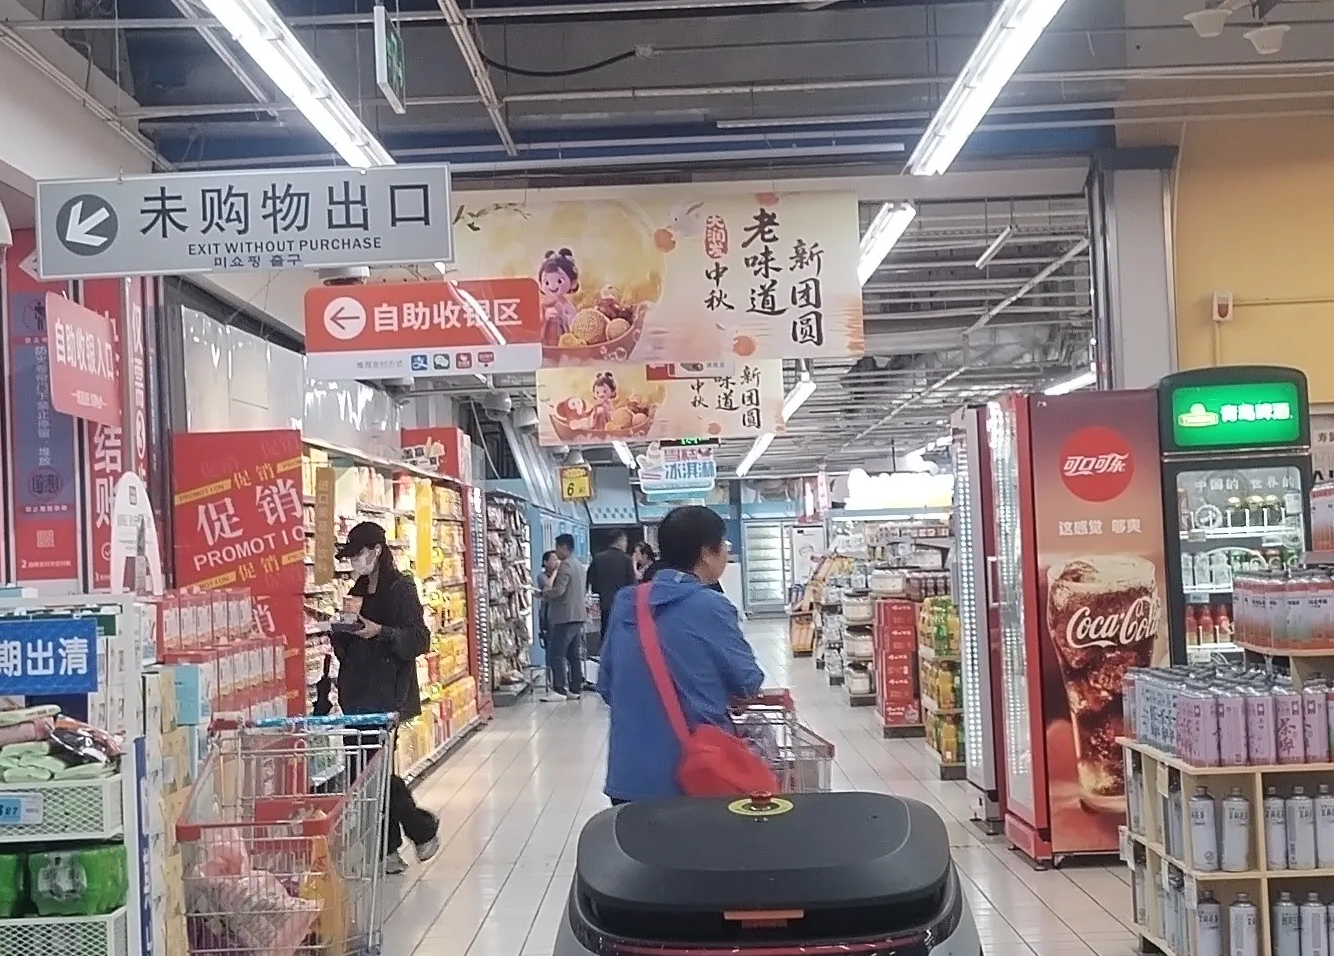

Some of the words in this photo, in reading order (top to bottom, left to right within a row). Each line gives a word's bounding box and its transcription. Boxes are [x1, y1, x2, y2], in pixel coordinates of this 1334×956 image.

[140, 180, 432, 239] 未购物出口
[188, 243, 221, 256] EXIT
[225, 239, 294, 254] WITHOUT
[298, 236, 382, 252] PURCHASE
[269, 254, 303, 267] 출구
[741, 208, 789, 316] 老味道
[704, 262, 735, 312] 中秋
[789, 239, 824, 347] 新团圆
[373, 298, 523, 333] 自助收银区
[55, 318, 115, 383] 自助收银入口
[715, 375, 739, 412] 味道
[740, 365, 761, 430] 新团圆
[1063, 452, 1130, 478] 可口可乐
[197, 478, 304, 547] 促销
[1058, 520, 1103, 537] 这感觉
[1111, 518, 1142, 535] 够爽
